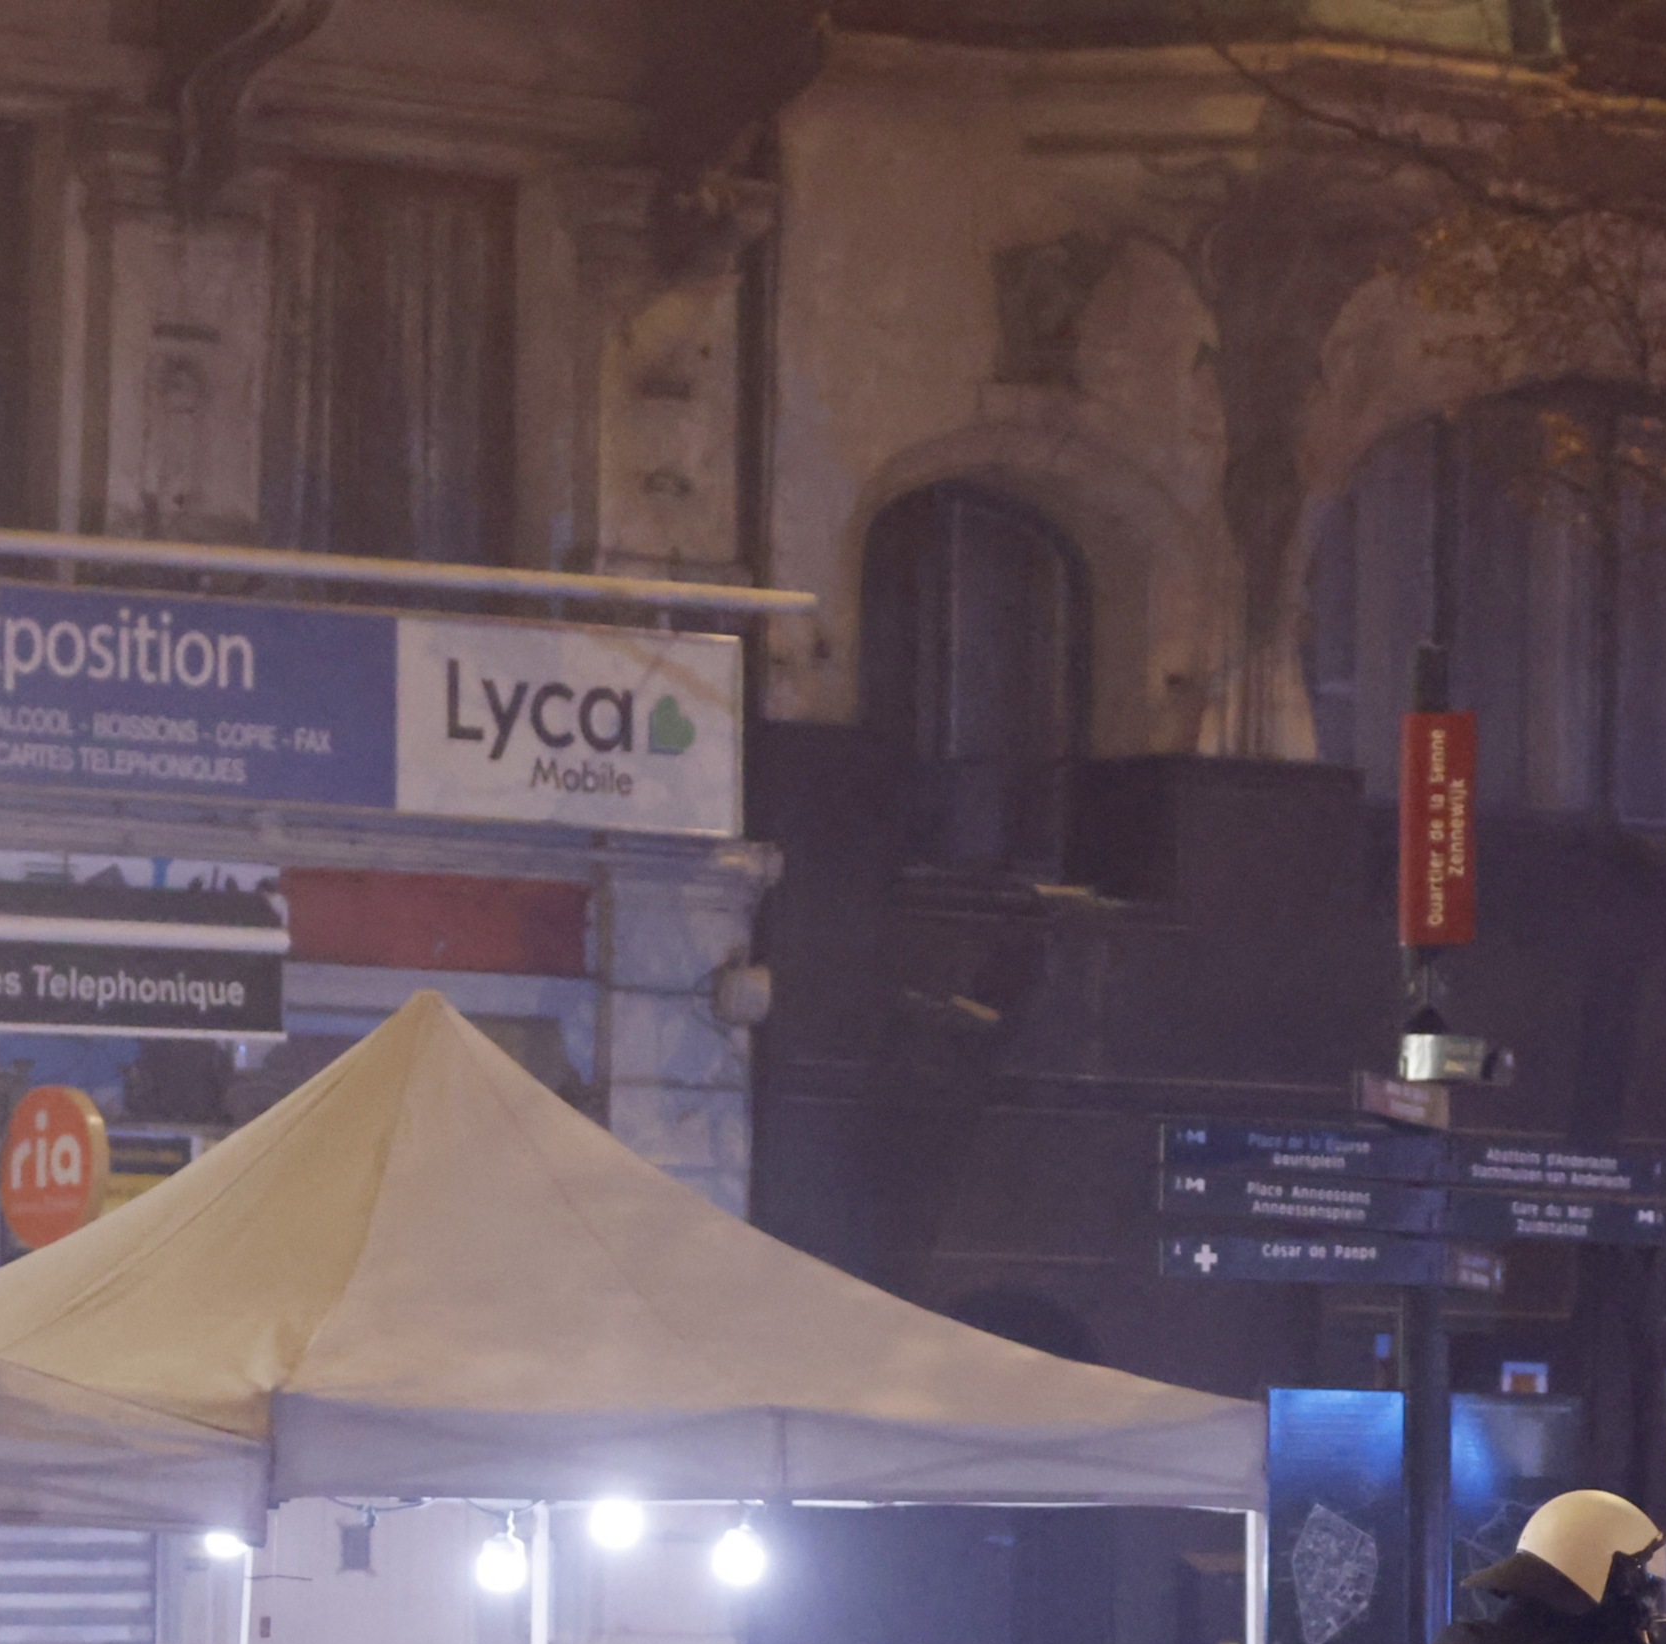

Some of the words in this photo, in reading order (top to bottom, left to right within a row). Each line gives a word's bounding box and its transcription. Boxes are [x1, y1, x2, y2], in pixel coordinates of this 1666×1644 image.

[445, 657, 635, 760] Lyca
[92, 711, 198, 743] BOISSONS
[215, 721, 278, 749] COPIE
[293, 727, 332, 752] FAX
[79, 746, 247, 782] TELEPHONIQUES
[1429, 728, 1446, 783] Senne
[532, 756, 634, 797] Mobile
[1429, 793, 1444, 810] la
[1428, 819, 1444, 842] de
[1448, 778, 1467, 876] Zennewijk
[1427, 850, 1445, 928] Quartier
[31, 963, 246, 1010] Telephonique
[10, 1108, 81, 1190] ria
[1246, 1180, 1283, 1195] Place
[1309, 1243, 1326, 1257] de
